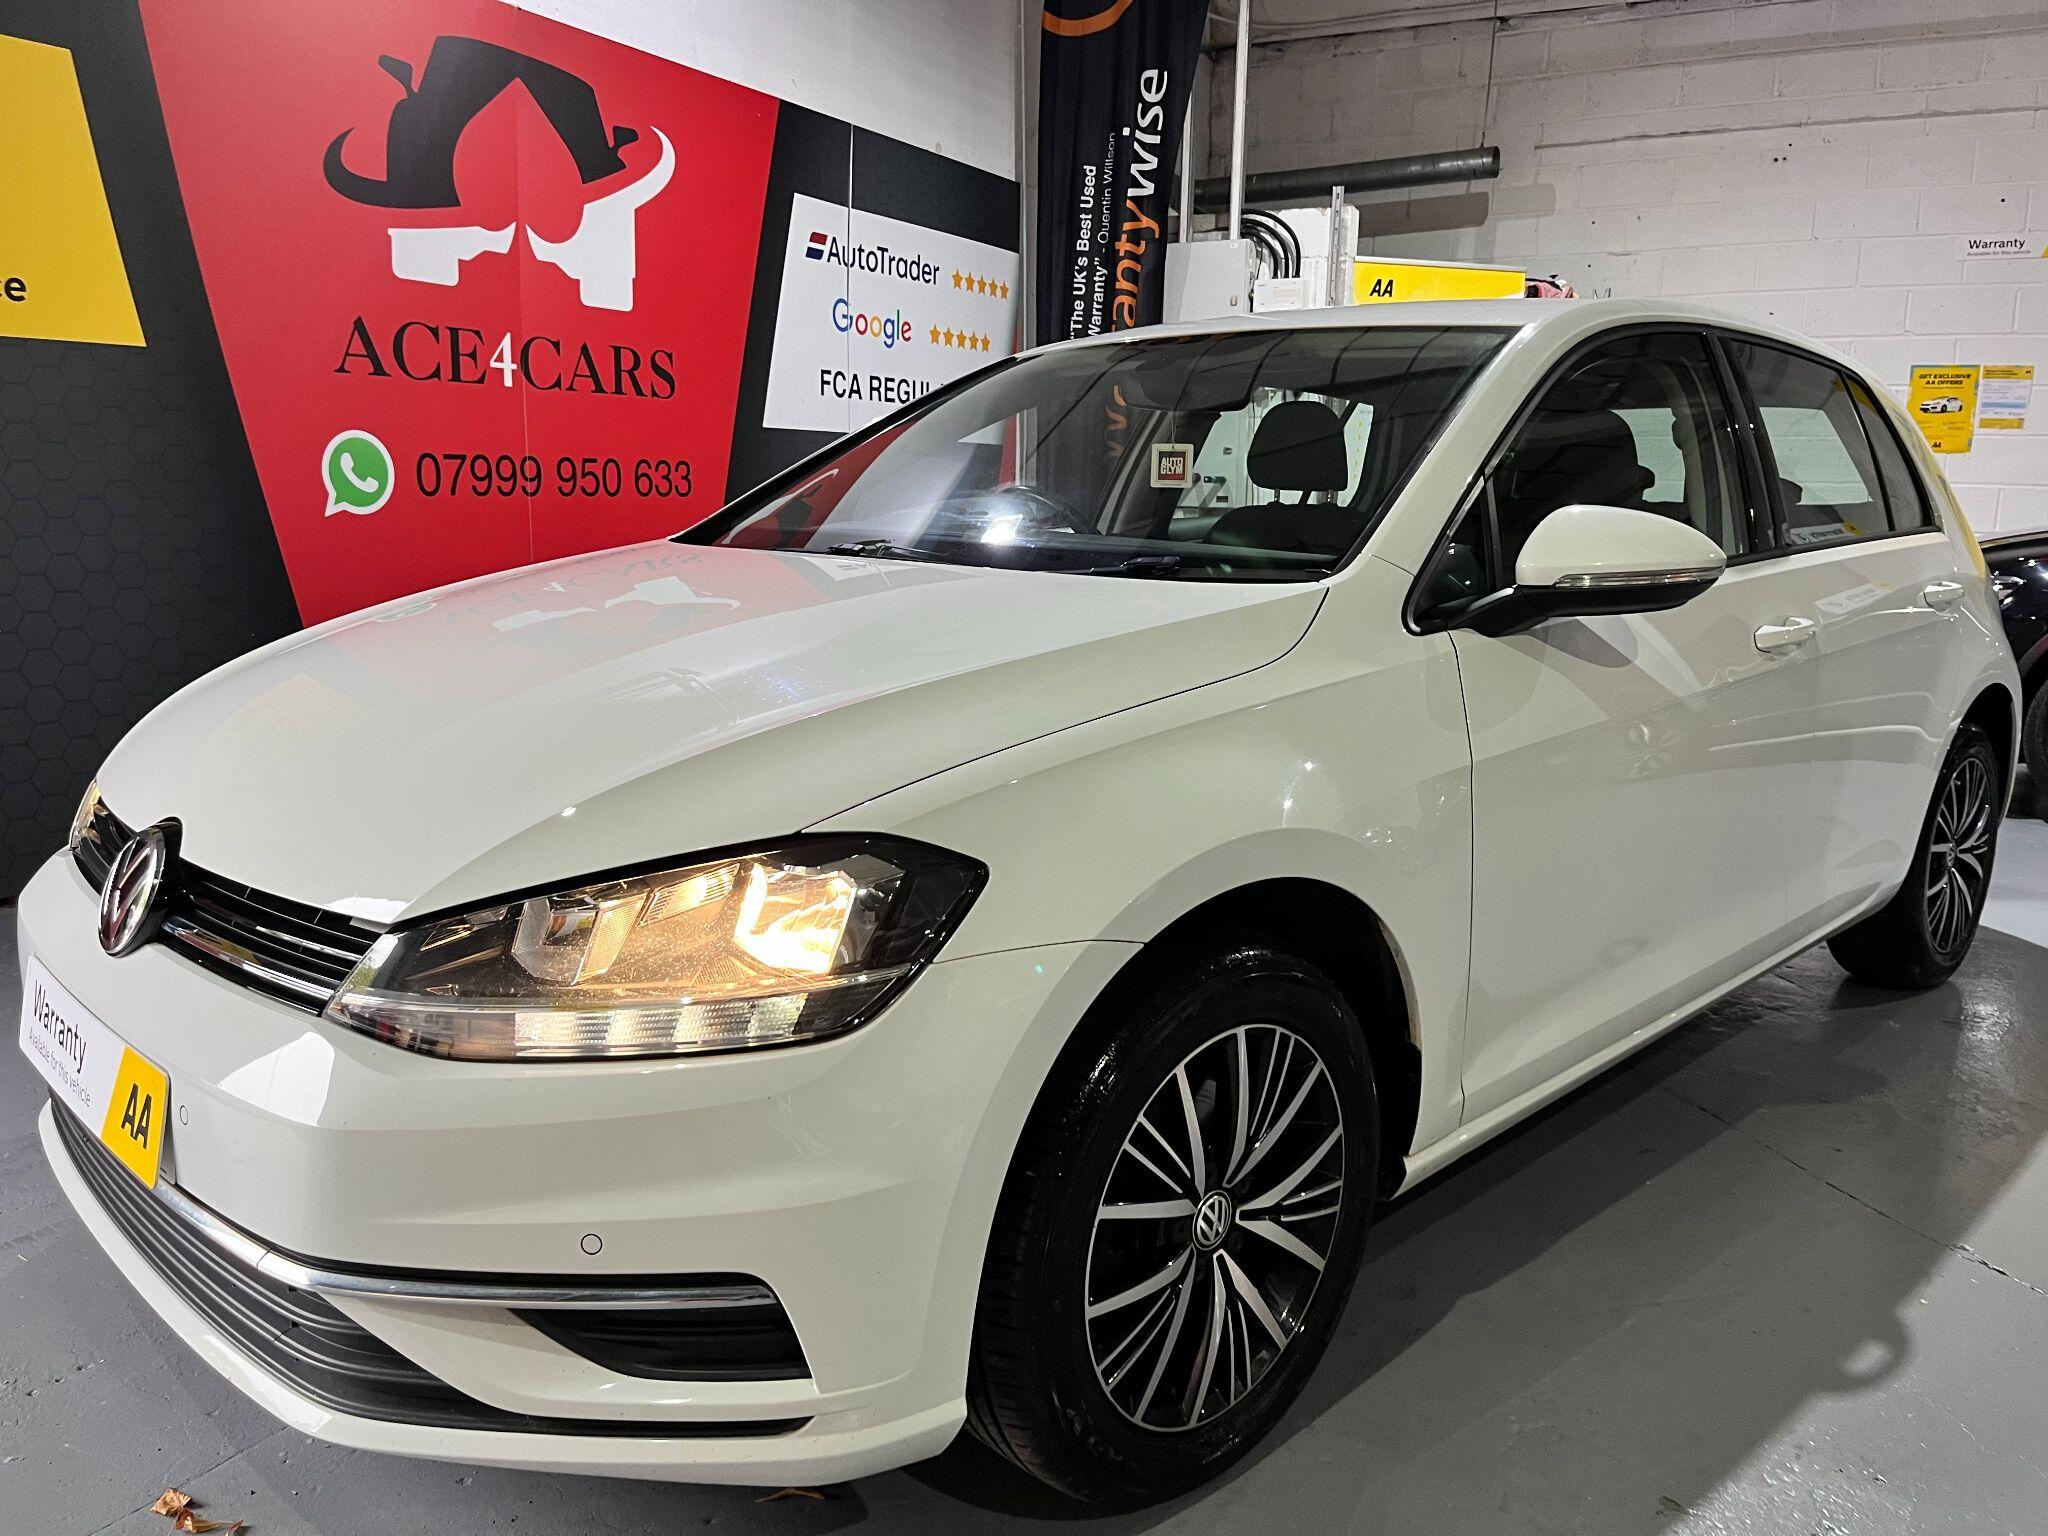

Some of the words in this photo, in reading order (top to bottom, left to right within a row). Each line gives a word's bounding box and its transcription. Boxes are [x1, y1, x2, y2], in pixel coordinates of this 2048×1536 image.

[1103, 132, 1116, 184] Willson
[1080, 165, 1097, 208] Used
[1111, 69, 1168, 332] antywise
[1076, 213, 1093, 251] Best
[1098, 188, 1112, 244] Quentin
[827, 237, 940, 285] AutoTrader
[1968, 238, 2026, 250] Warranty
[1073, 256, 1089, 296] UK's
[1369, 278, 1394, 297] AA
[832, 298, 912, 349] Google
[333, 315, 677, 399] ACE4CARS
[820, 369, 862, 400] FCA
[416, 452, 543, 498] 07999
[556, 456, 622, 498] 950
[633, 458, 692, 498] 633
[1161, 457, 1184, 466] AUTO
[34, 979, 87, 1074] Warranty
[120, 1083, 152, 1150] AA
